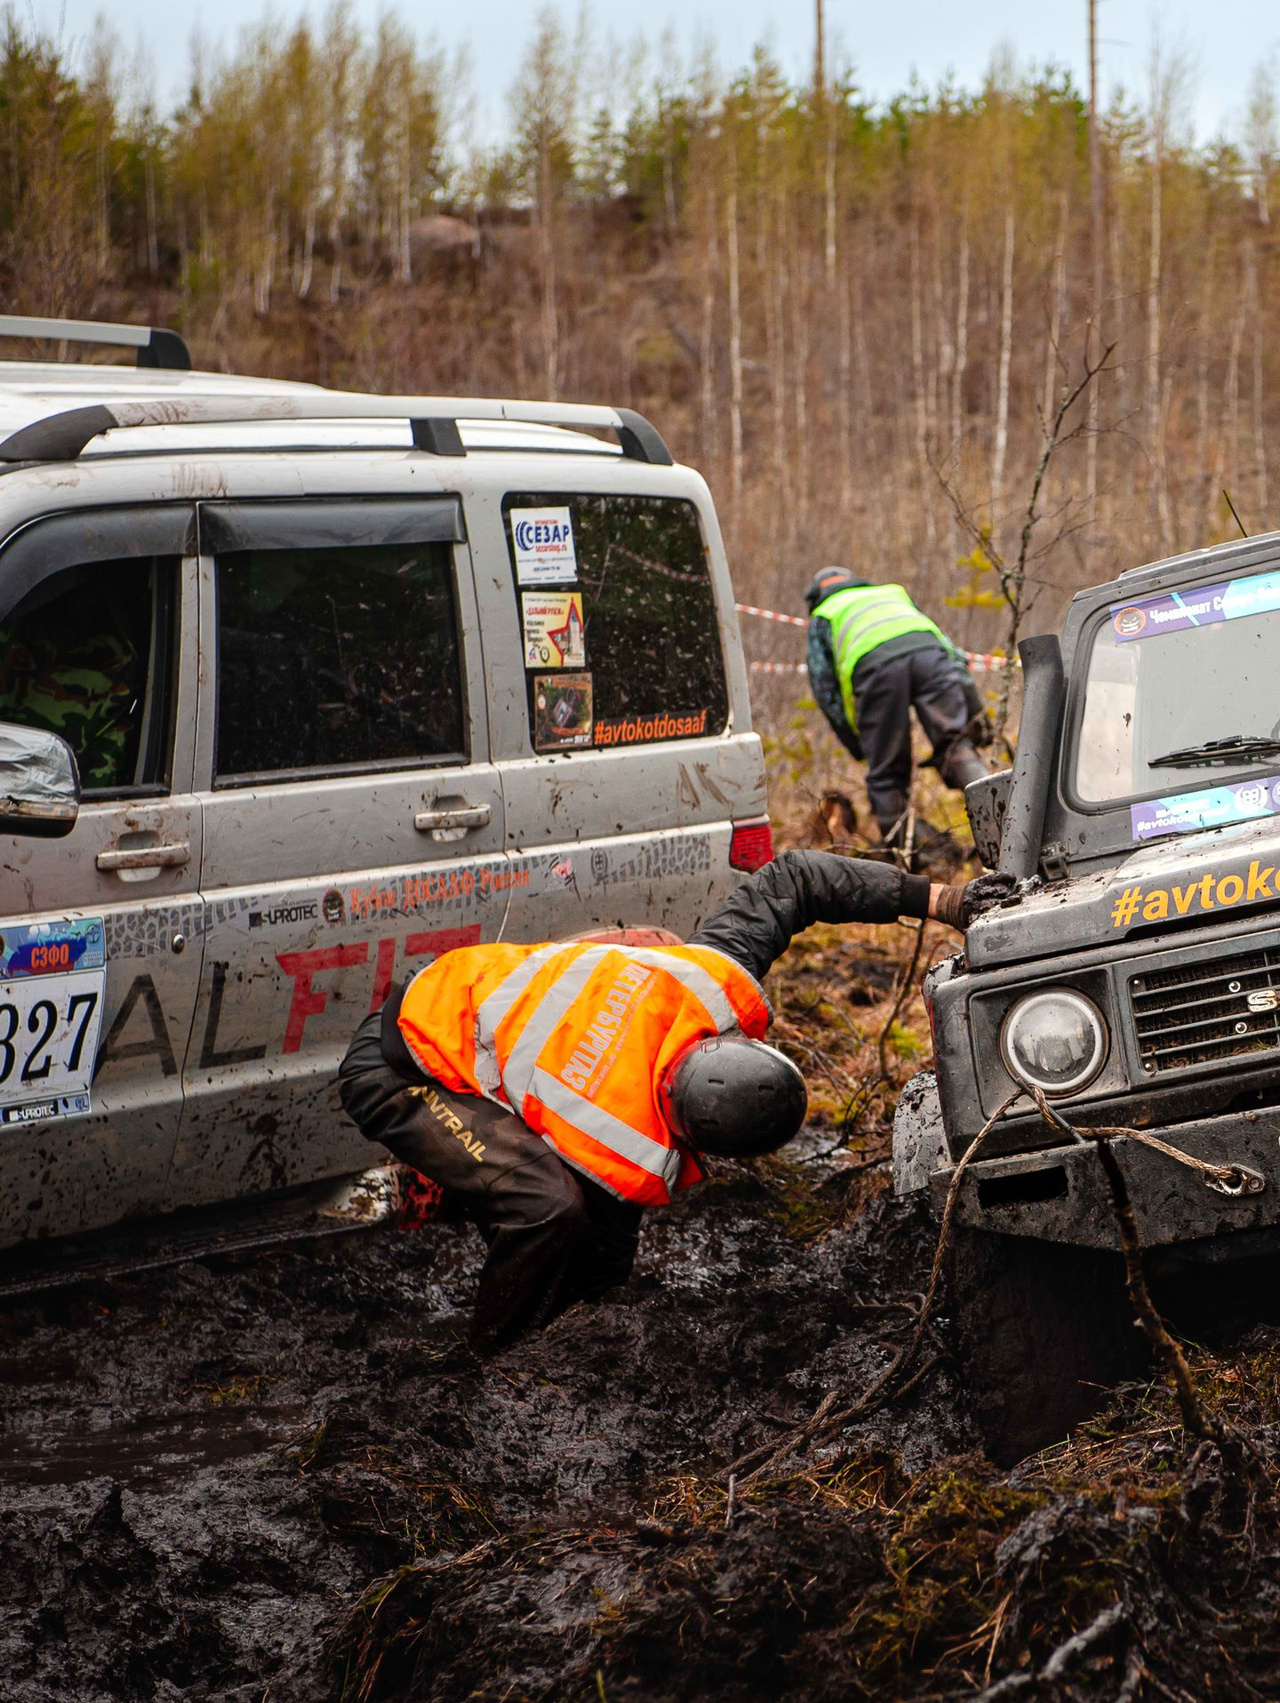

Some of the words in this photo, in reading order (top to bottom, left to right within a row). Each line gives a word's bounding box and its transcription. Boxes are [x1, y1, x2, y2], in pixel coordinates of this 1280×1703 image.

[525, 525, 570, 544] СЕЗАР
[595, 710, 706, 744] #avtokotdosaaf
[31, 943, 70, 969] СЗФО
